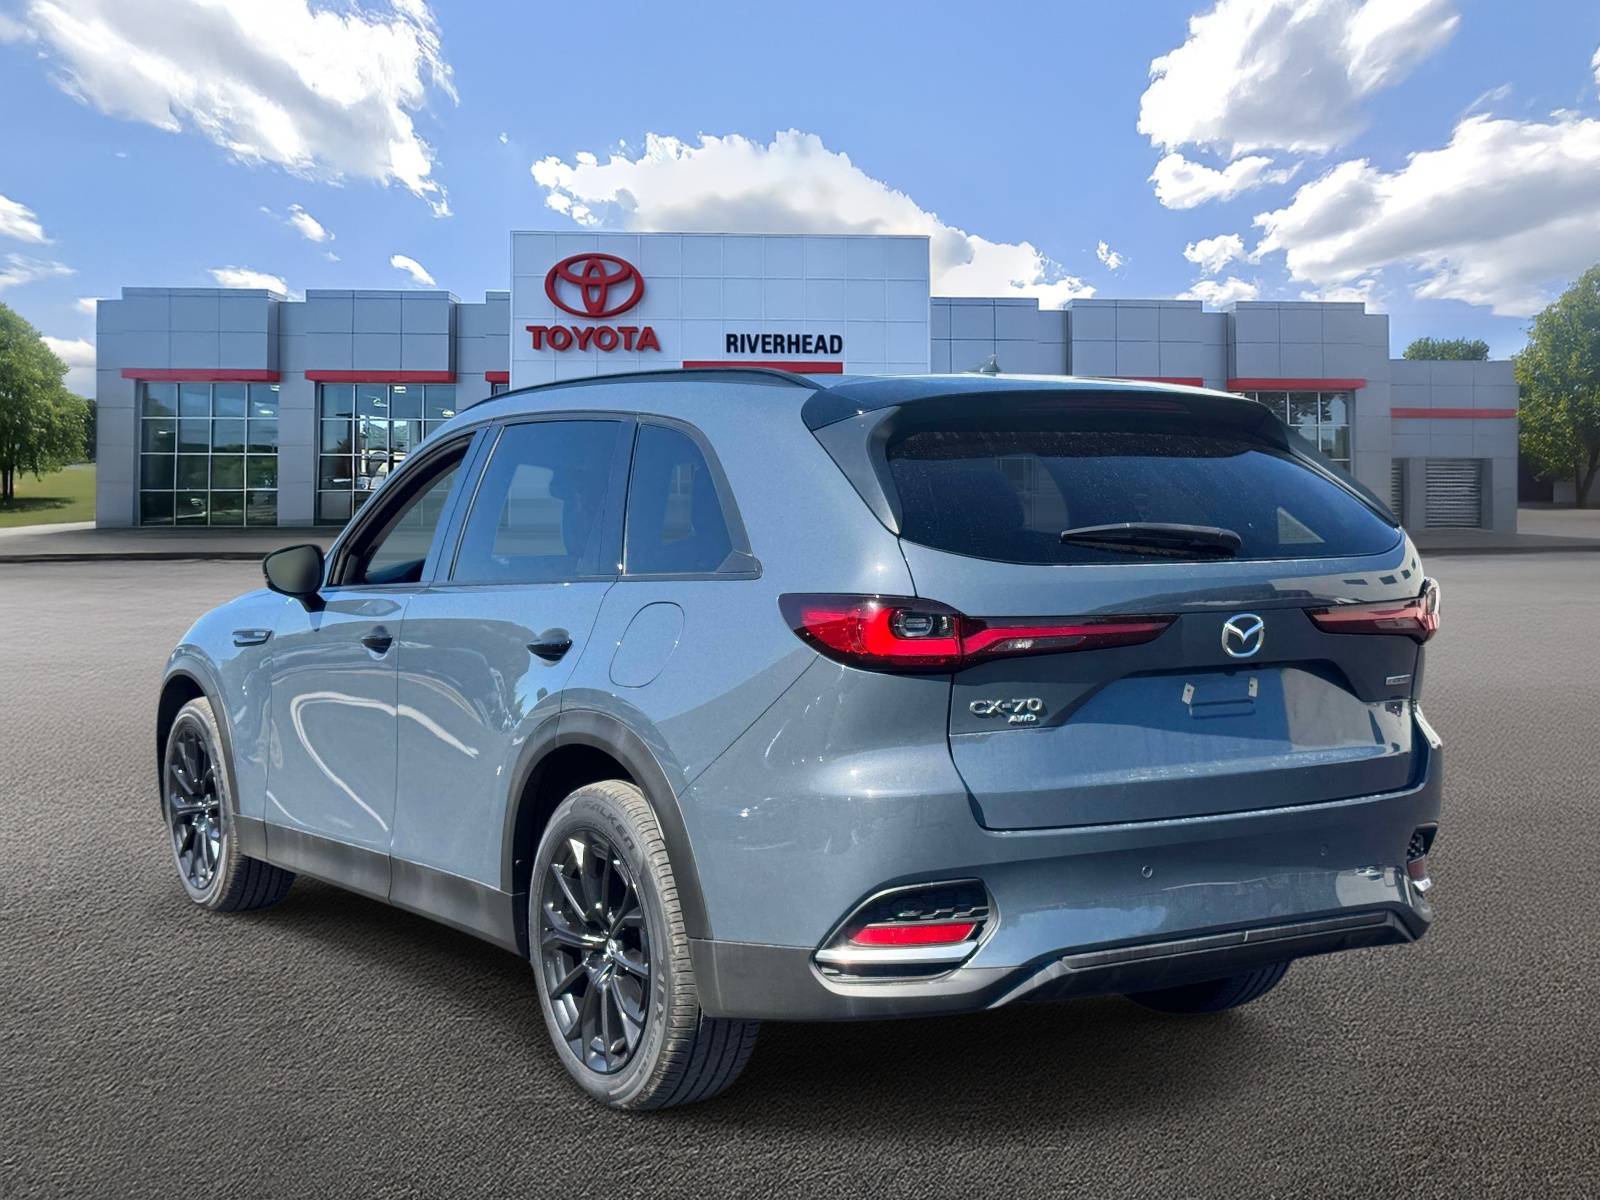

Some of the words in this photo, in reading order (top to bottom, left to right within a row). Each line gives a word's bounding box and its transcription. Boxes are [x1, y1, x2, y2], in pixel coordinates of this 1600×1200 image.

[525, 325, 661, 352] TOYOTA
[725, 333, 843, 354] RIVERHEAD
[969, 697, 1043, 715] CX-70
[1007, 713, 1037, 724] AWD
[582, 800, 636, 852] FALKEN
